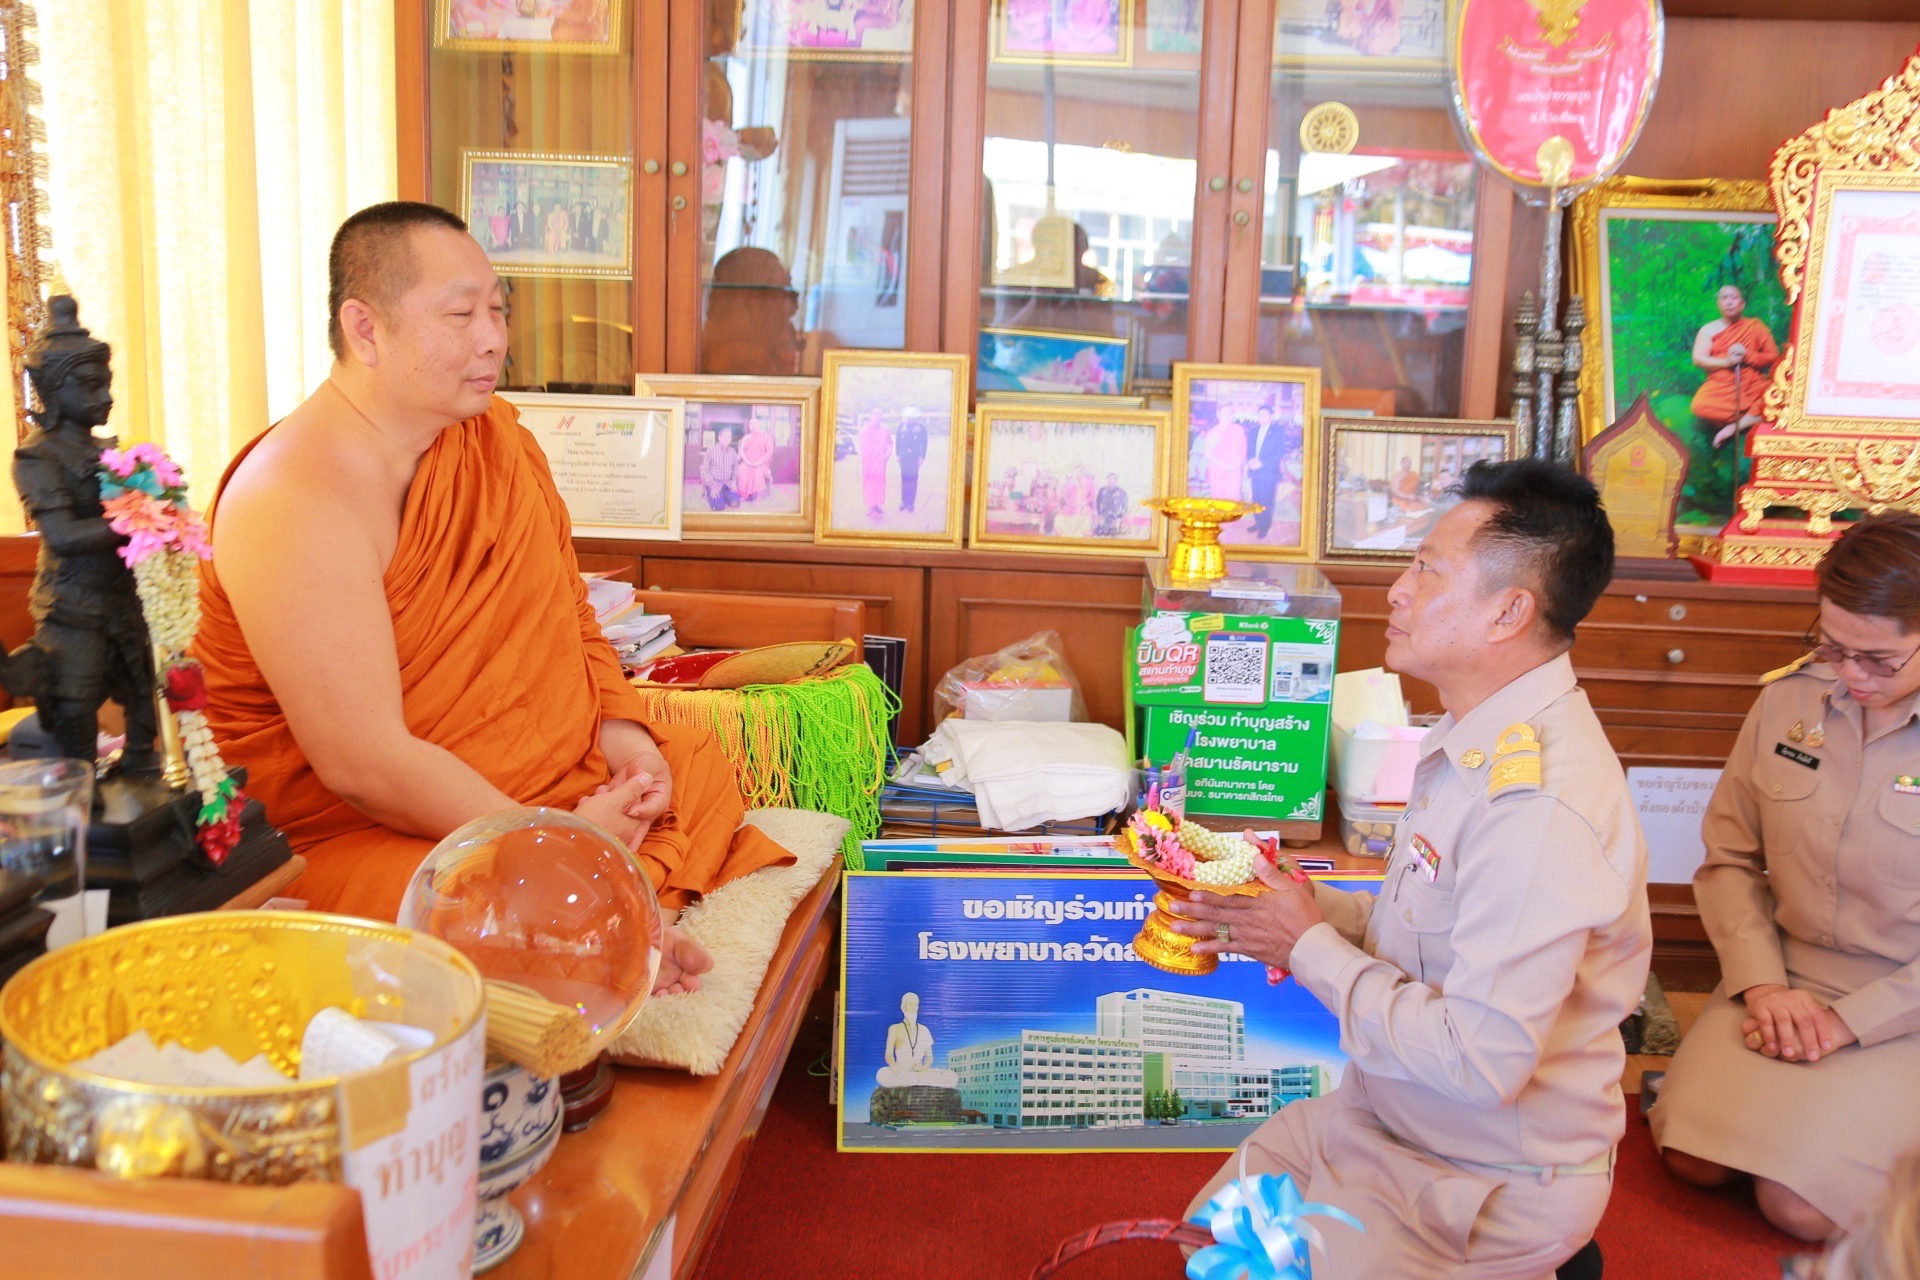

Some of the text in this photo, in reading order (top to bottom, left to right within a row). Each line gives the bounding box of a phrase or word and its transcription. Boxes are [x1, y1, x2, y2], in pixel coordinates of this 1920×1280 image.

[1139, 663, 1197, 678] สแกนทำบุญ
[1168, 710, 1311, 733] เชิญร่วม ทำบุญสร้าง
[1195, 731, 1277, 751] โรงพยาบาล
[1258, 779, 1276, 791] โดย
[1208, 791, 1286, 803] ธนาคารกสิกรไทย
[962, 893, 1157, 925] ขอเชิญร่วมทำ
